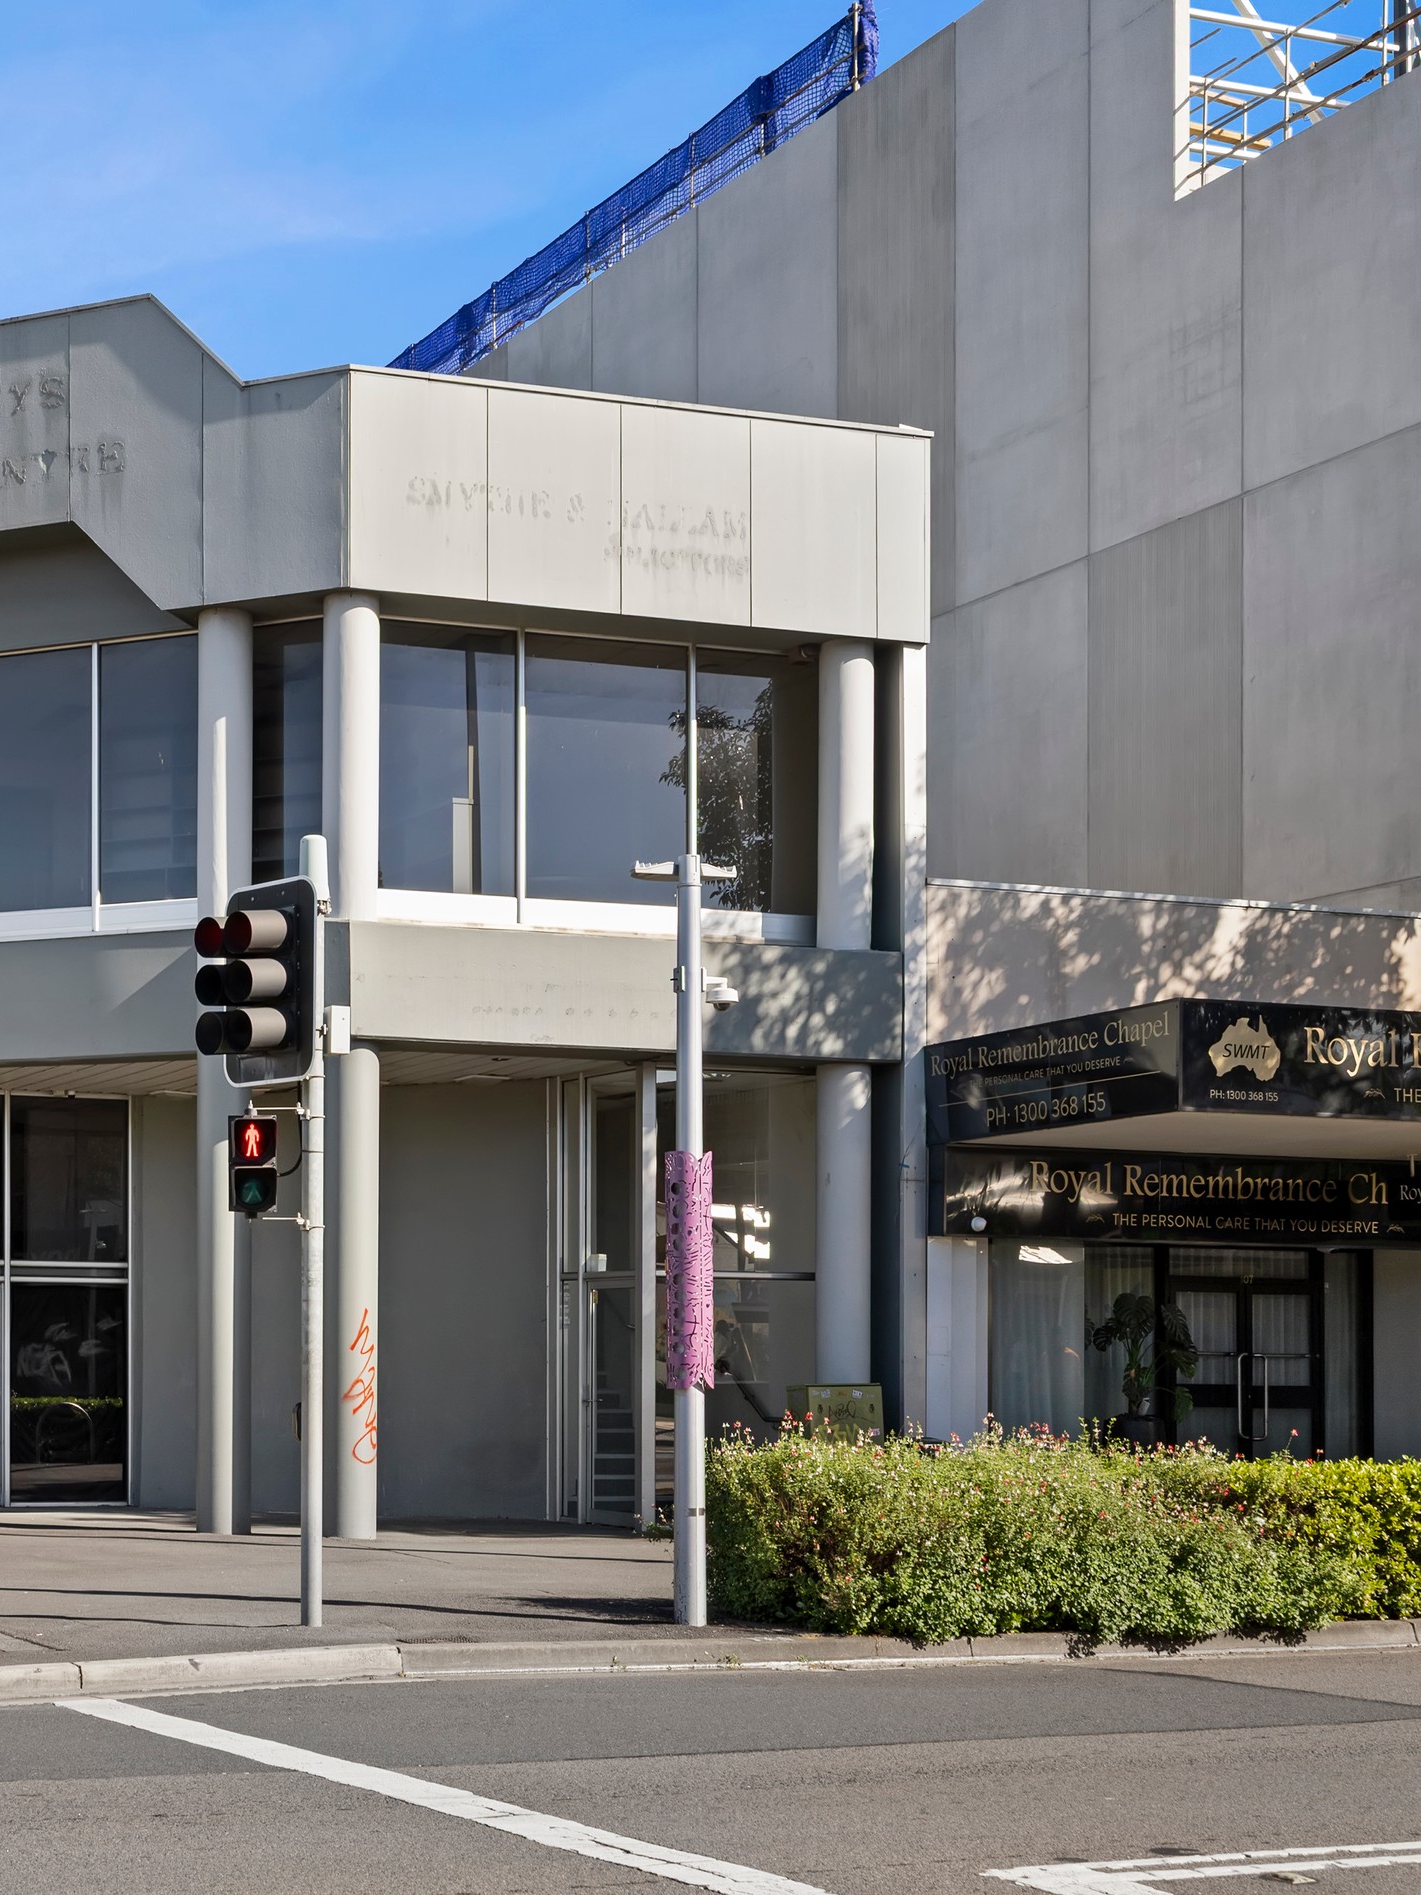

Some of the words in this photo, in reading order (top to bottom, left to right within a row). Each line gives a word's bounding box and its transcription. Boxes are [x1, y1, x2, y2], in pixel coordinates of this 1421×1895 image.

[931, 1048, 973, 1080] Royal
[978, 1030, 1099, 1069] Remembrance
[1104, 1010, 1170, 1047] Chapel
[1222, 1043, 1271, 1060] SWMT
[1303, 1026, 1400, 1078] Royal
[984, 1072, 1023, 1087] PERSONAL
[1024, 1069, 1044, 1081] CARE
[1046, 1066, 1065, 1078] THAT
[1066, 1062, 1083, 1074] YOU
[1085, 1056, 1121, 1070] DESERVE
[1014, 1100, 1048, 1124] 1300
[1051, 1095, 1078, 1118] 368
[1082, 1091, 1106, 1114] 155
[1209, 1089, 1225, 1100] PH:
[1227, 1090, 1247, 1101] 1300
[1248, 1090, 1264, 1101] 368
[1265, 1091, 1279, 1102] 155
[1394, 1087, 1421, 1103] THE
[1029, 1160, 1114, 1203] Royal
[1123, 1164, 1339, 1203] Remembrance
[1112, 1212, 1138, 1226] THE
[1141, 1213, 1212, 1229] PERSONAL
[1215, 1216, 1250, 1230] CARE
[1254, 1217, 1286, 1231] THAT
[1289, 1218, 1317, 1232] YOU
[1321, 1220, 1379, 1234] DESERVE
